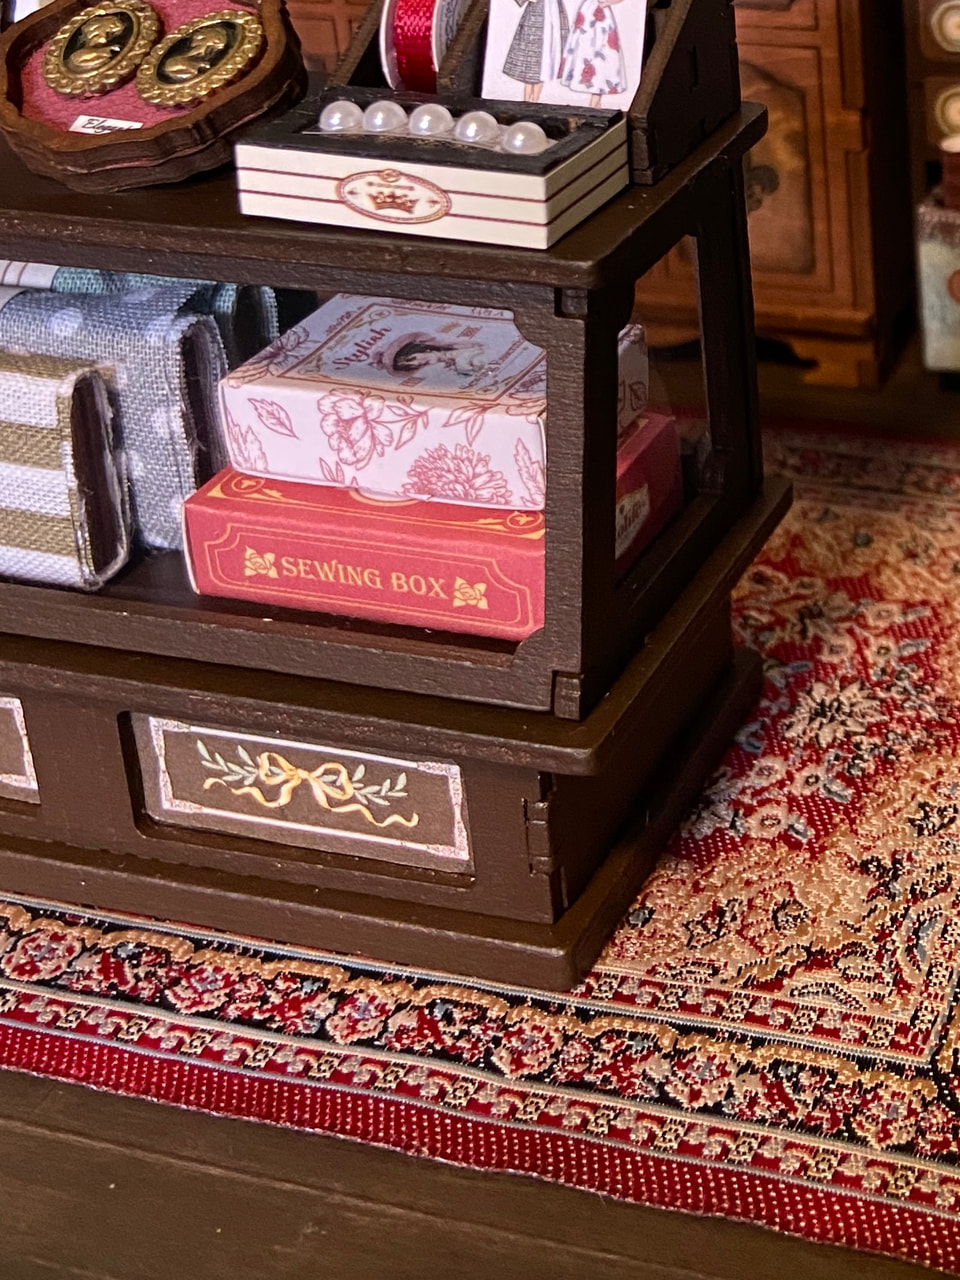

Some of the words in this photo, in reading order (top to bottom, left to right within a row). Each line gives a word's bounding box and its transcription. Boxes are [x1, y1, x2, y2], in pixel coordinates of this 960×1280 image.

[332, 326, 392, 370] Stylish
[281, 556, 384, 590] SEWING
[390, 571, 449, 600] BOX
